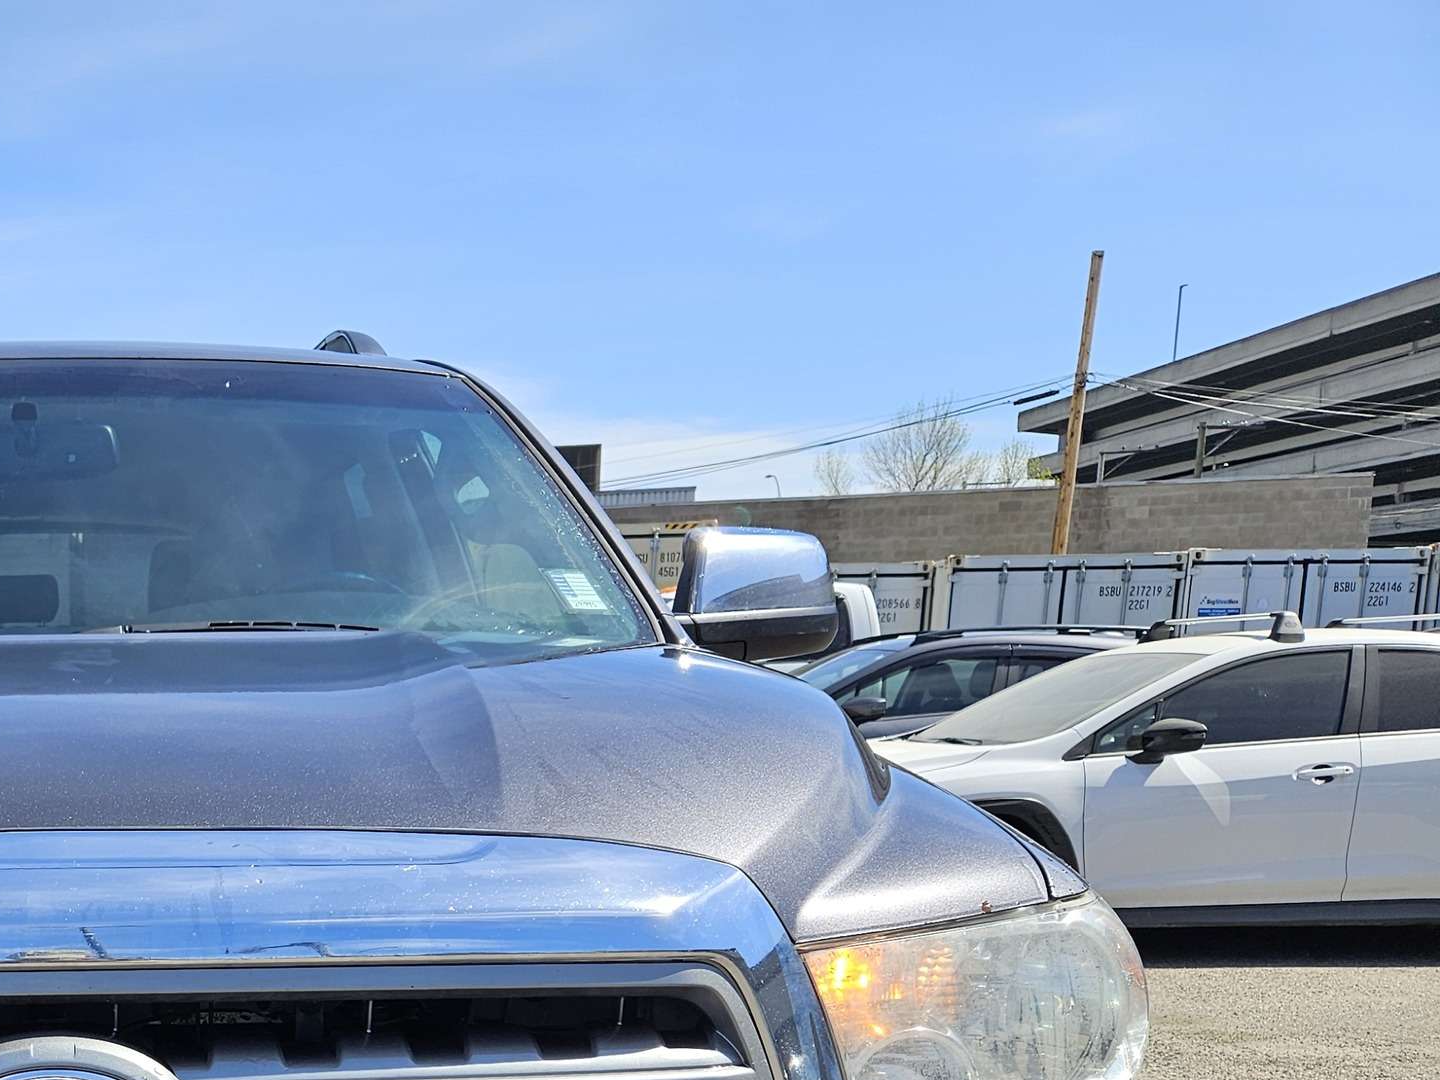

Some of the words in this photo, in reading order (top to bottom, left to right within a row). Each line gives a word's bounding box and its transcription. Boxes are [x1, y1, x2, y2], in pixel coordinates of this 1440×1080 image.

[660, 552, 681, 563] 8107
[1099, 585, 1121, 597] BSBU
[1129, 585, 1163, 597] 217219
[1333, 581, 1356, 593] BSBU
[1369, 581, 1402, 593] 224146
[1409, 582, 1416, 593] 2
[1128, 599, 1150, 611] 22G1
[1367, 595, 1389, 607] 22G1
[878, 612, 896, 623] 2G1
